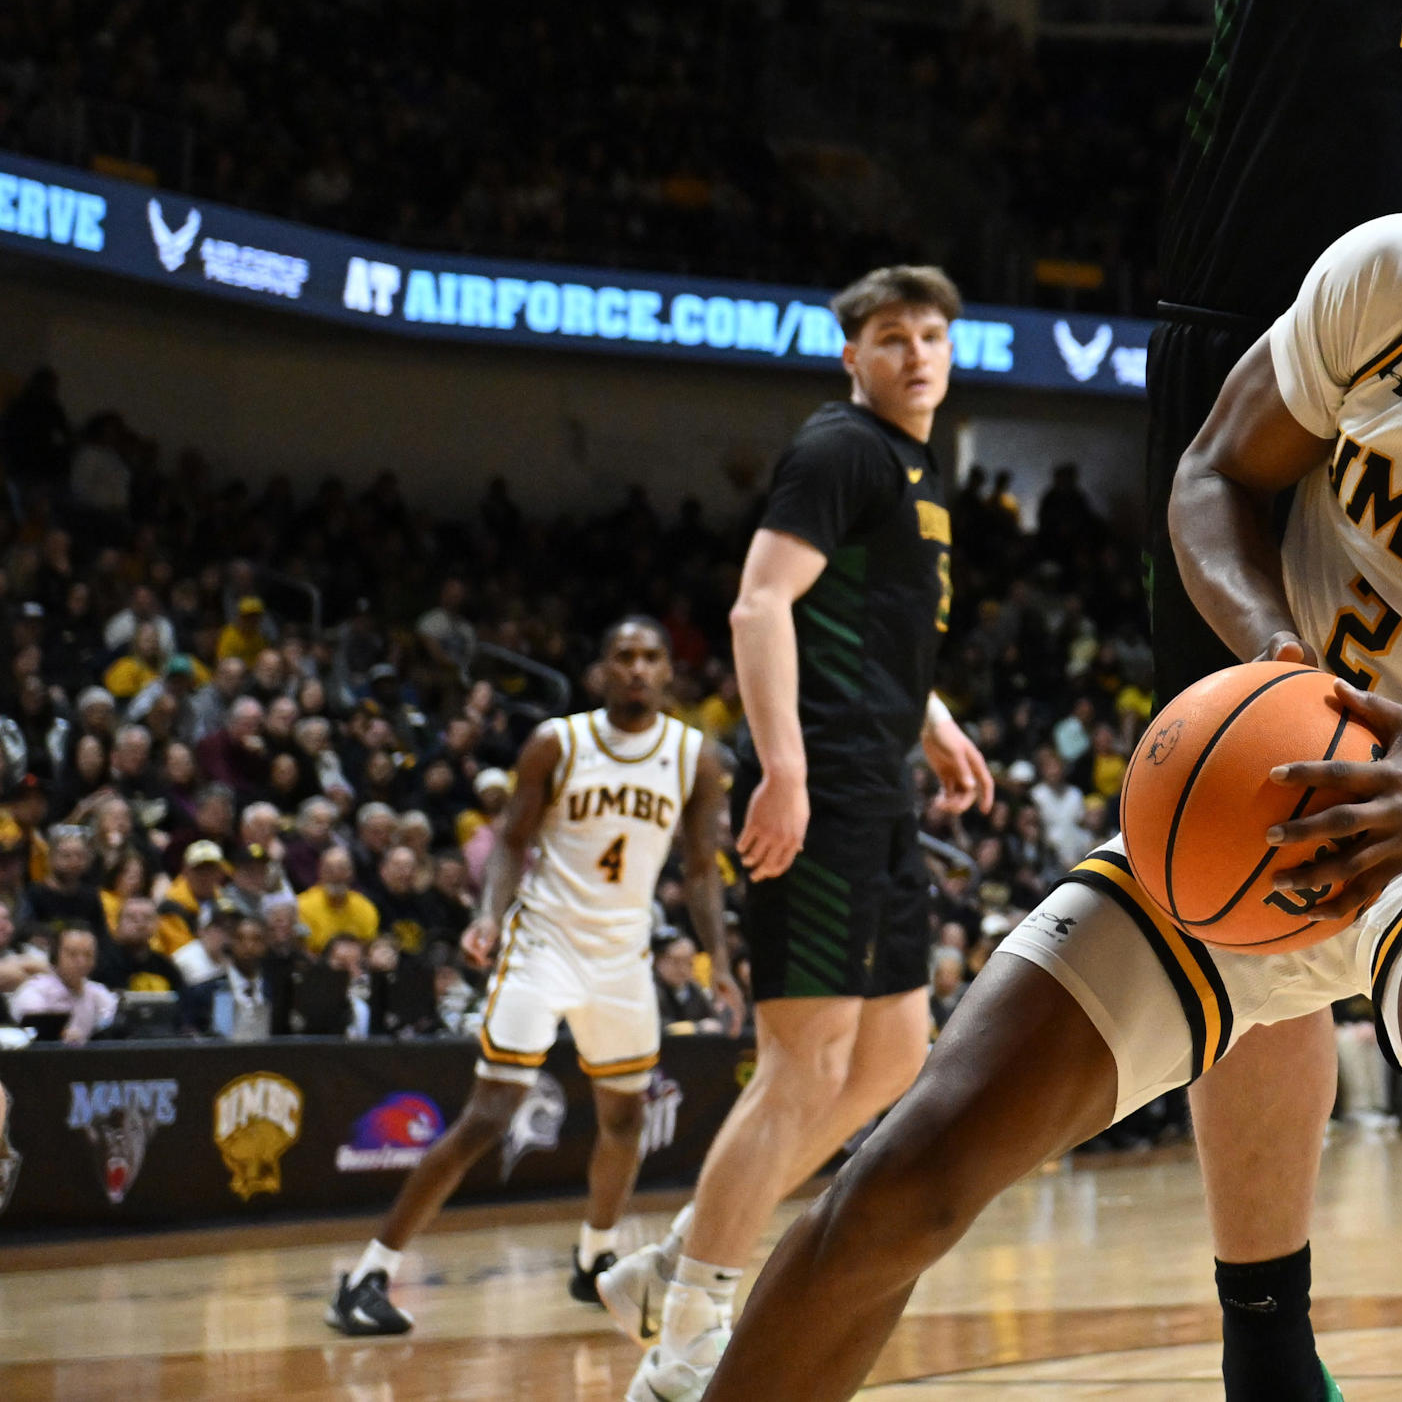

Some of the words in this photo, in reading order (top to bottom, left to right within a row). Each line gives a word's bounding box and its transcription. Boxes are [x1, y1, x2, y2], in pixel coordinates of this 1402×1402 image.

[343, 256, 401, 317] AT
[568, 783, 675, 830] UMBC
[596, 832, 630, 884] 4
[67, 1078, 180, 1130] MAINE
[215, 1076, 302, 1143] UMBC
